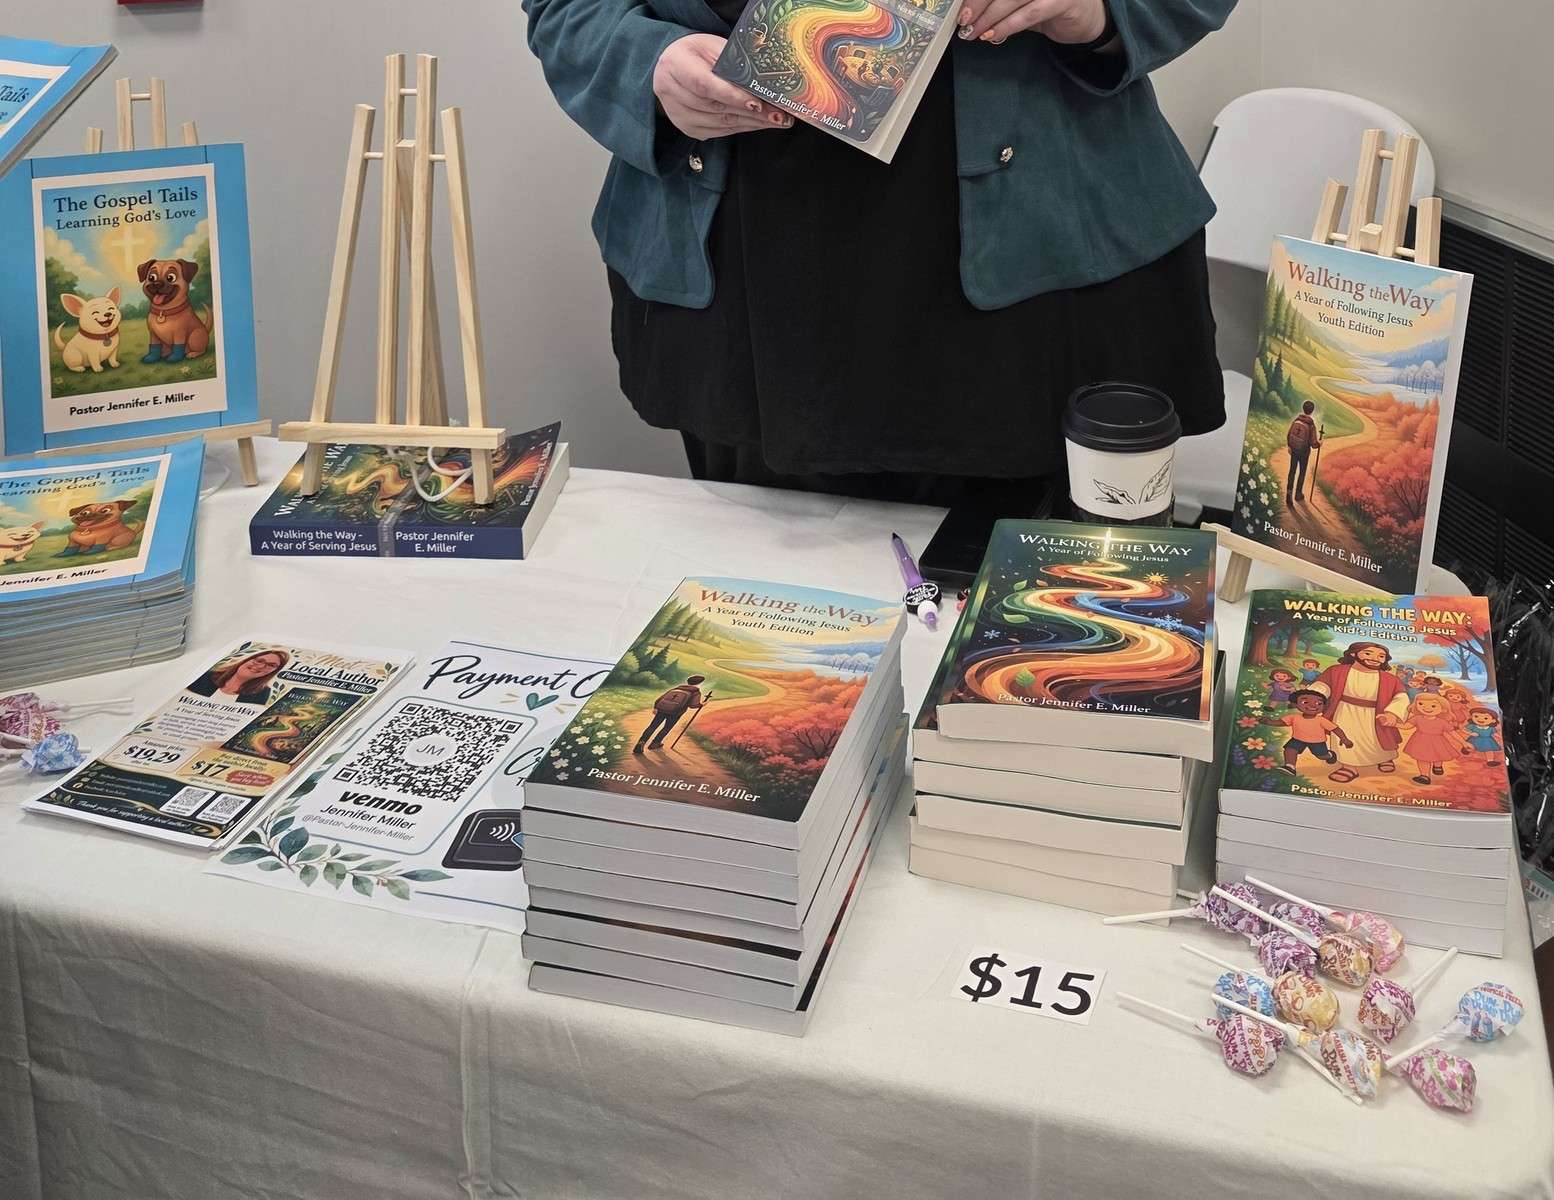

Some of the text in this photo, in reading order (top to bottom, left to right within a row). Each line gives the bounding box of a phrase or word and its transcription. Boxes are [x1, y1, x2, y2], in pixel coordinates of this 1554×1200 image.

[749, 79, 846, 131] Pastor Jennifer E. Miller
[53, 187, 198, 213] The Gospel Tails
[56, 208, 197, 230] Learning God's Love
[1287, 261, 1435, 317] Walking the Way
[1294, 291, 1414, 328] A Year of Following Jesus
[1318, 312, 1385, 338] Youth Edition
[69, 393, 195, 416] Pastor Jennifer E. Miller
[0, 487, 62, 498] earning
[111, 476, 145, 485] Love
[37, 472, 101, 486] Gospel
[107, 467, 150, 478] Tails
[261, 541, 377, 554] A Year of Serving Jesus
[273, 530, 357, 542] Walking the Way
[396, 531, 474, 542] Pastor Jennifer
[1019, 534, 1192, 557] WALKING THE WAY
[415, 543, 457, 553] E. Miller
[1087, 550, 1140, 562] Following
[1141, 555, 1169, 563] Jesus
[1263, 522, 1383, 574] Pastor Jennifer E. Miller
[71, 567, 109, 578] Miller
[700, 590, 879, 628] Walking the Way
[714, 607, 741, 617] Year
[743, 610, 756, 618] of
[758, 611, 816, 627] Following
[818, 619, 851, 632] Jesus
[1284, 600, 1472, 625] WALKING THE WAY:
[730, 619, 815, 636] Youth Edition
[1306, 614, 1334, 623] Year
[1337, 617, 1351, 625] of
[1353, 618, 1415, 633] Following
[1419, 624, 1457, 636] Jesus
[1333, 625, 1418, 643] Kid's Edition
[282, 672, 305, 681] Pastor
[306, 677, 340, 687] Jennifer
[348, 684, 372, 693] Miller
[288, 662, 384, 685] Local Author
[422, 655, 577, 699] Payment
[179, 696, 257, 716] WALKING THE WAY
[998, 693, 1151, 713] Pastor Jennifer E. Miller
[123, 744, 180, 764] $19.29
[416, 744, 446, 757] JM
[191, 760, 229, 777] $17
[587, 768, 760, 803] Pastor Jennifer E. Miller
[1291, 784, 1334, 797] Pastor
[1338, 790, 1393, 803] Jennifer
[1411, 797, 1452, 808] Miller
[338, 790, 423, 817] venmo
[301, 814, 415, 842] @Pastor-Jennifer-Miller
[320, 805, 417, 830] Jennifer Miller
[959, 953, 1096, 1016] $15
